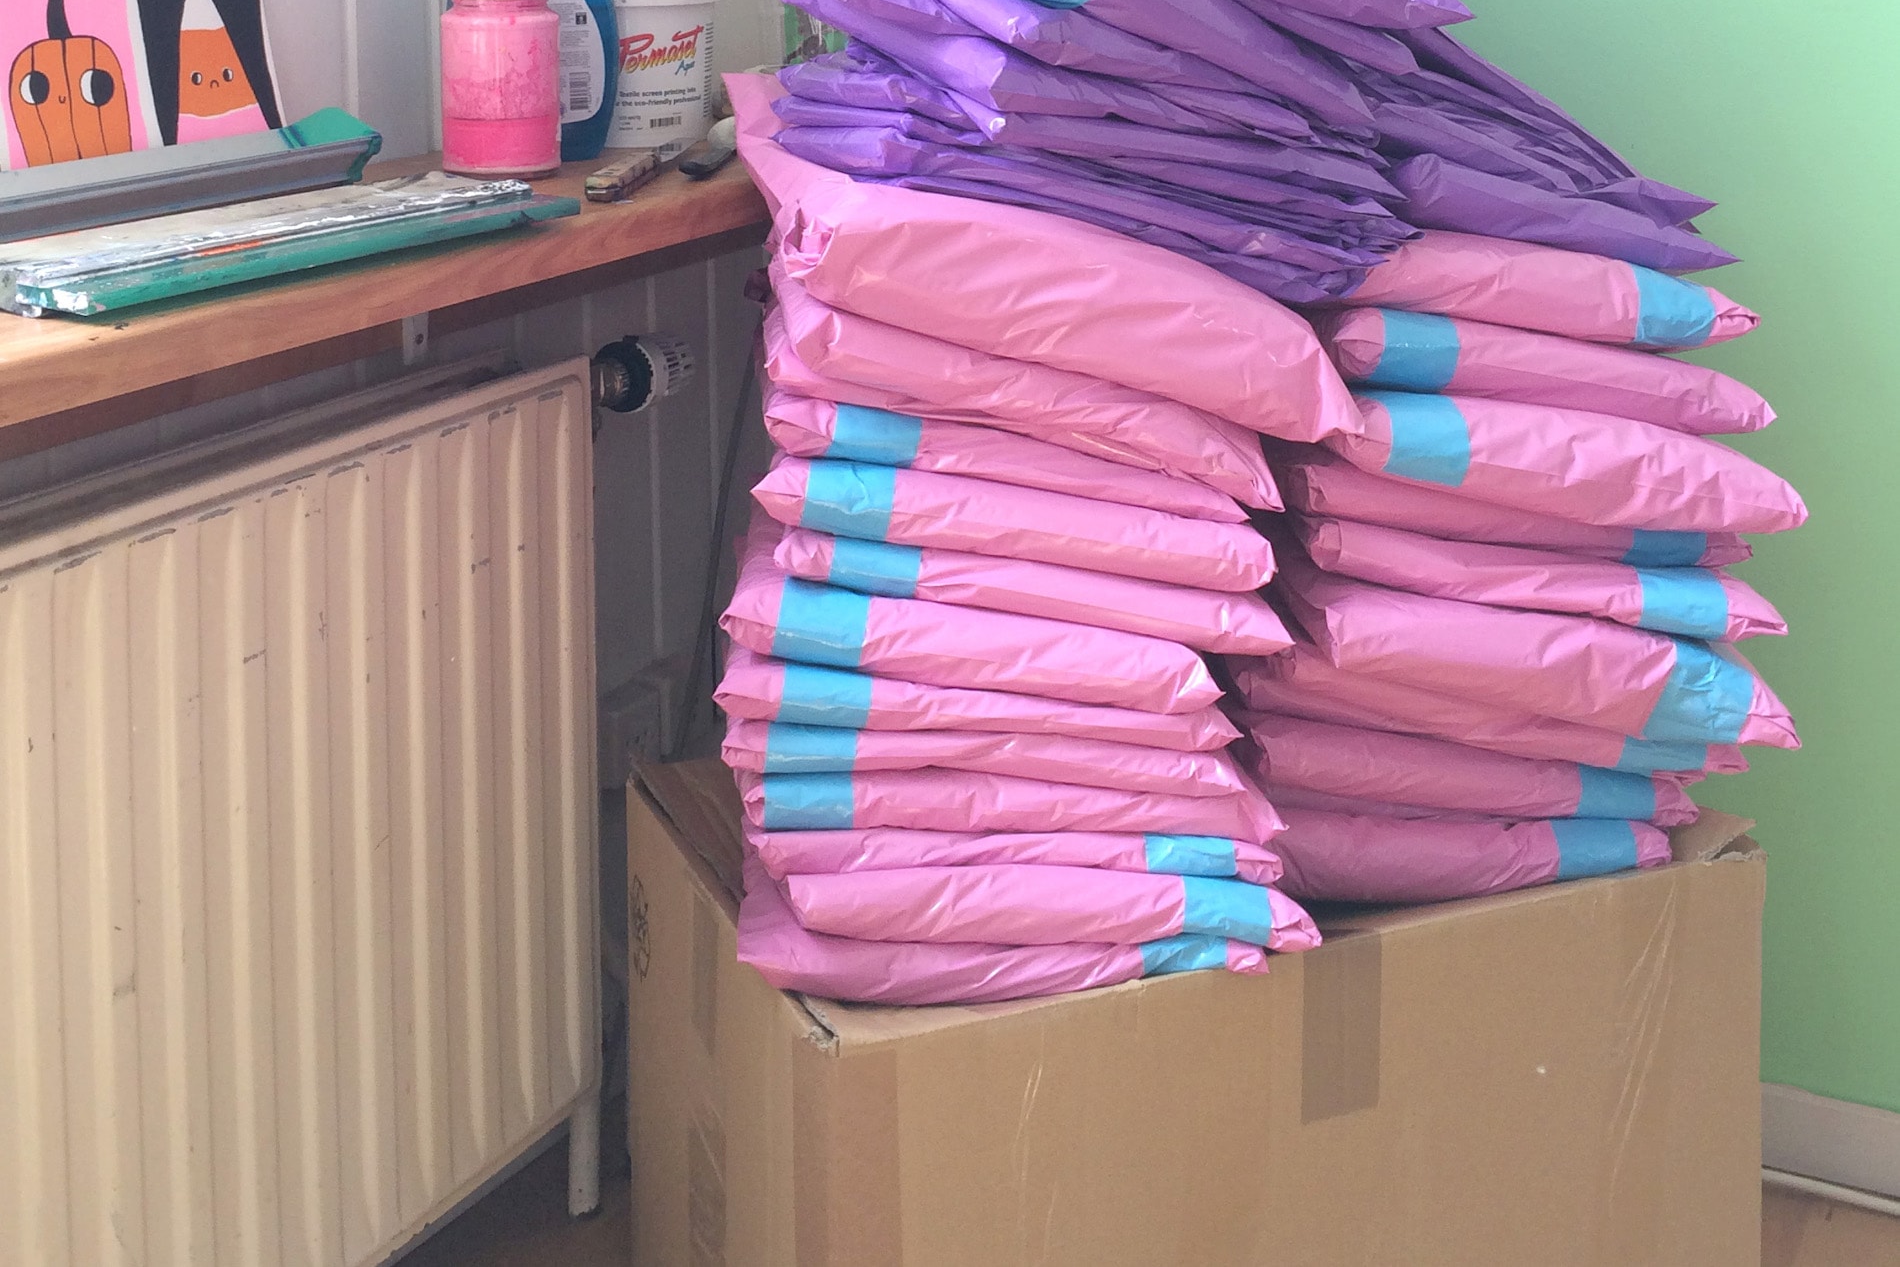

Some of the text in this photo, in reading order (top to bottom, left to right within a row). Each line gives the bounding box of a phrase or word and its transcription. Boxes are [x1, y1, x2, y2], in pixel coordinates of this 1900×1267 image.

[619, 25, 704, 74] Permaset
[664, 88, 686, 96] printing
[634, 98, 672, 106] eco-friendly
